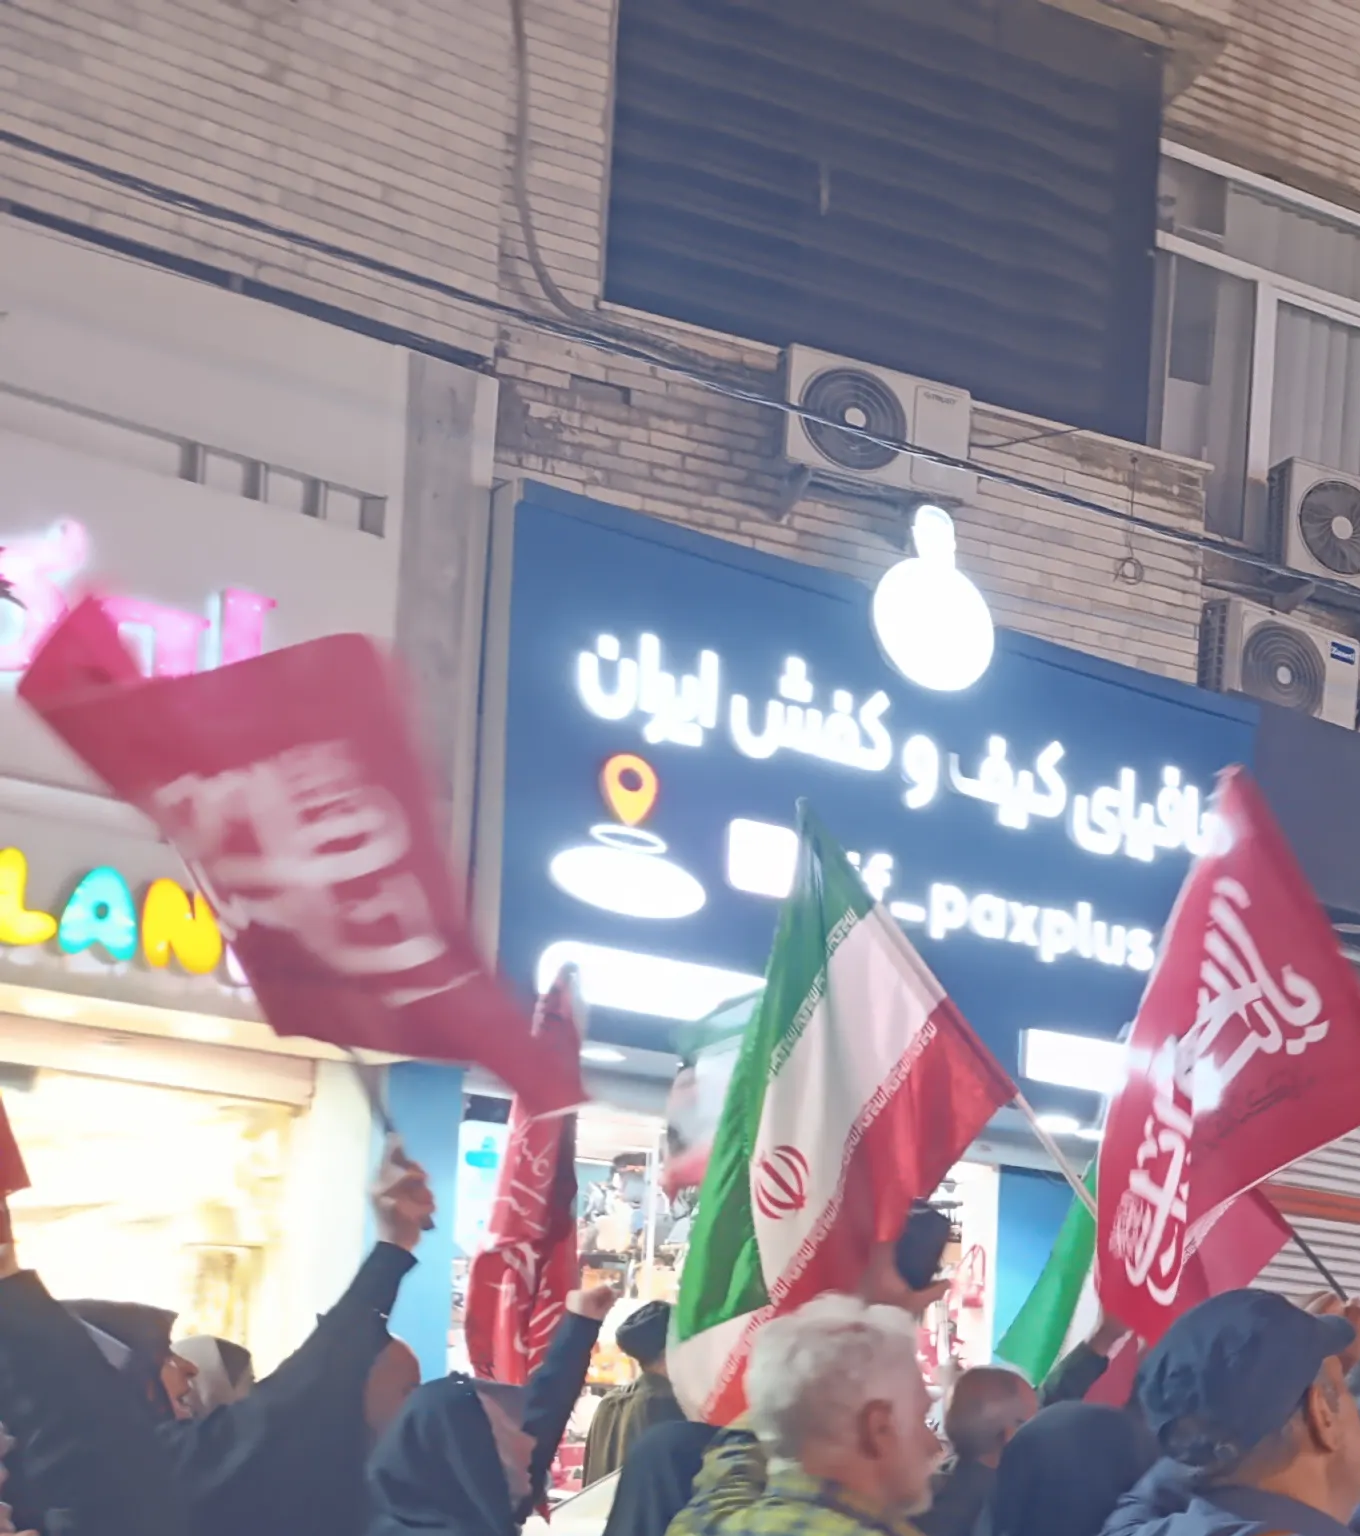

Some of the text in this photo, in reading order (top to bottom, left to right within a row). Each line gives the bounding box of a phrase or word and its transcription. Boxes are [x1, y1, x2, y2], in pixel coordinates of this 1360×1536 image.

[576, 632, 721, 748] ایران
[728, 655, 893, 773] کفش
[902, 732, 939, 810] و
[948, 733, 1068, 831] کیف
